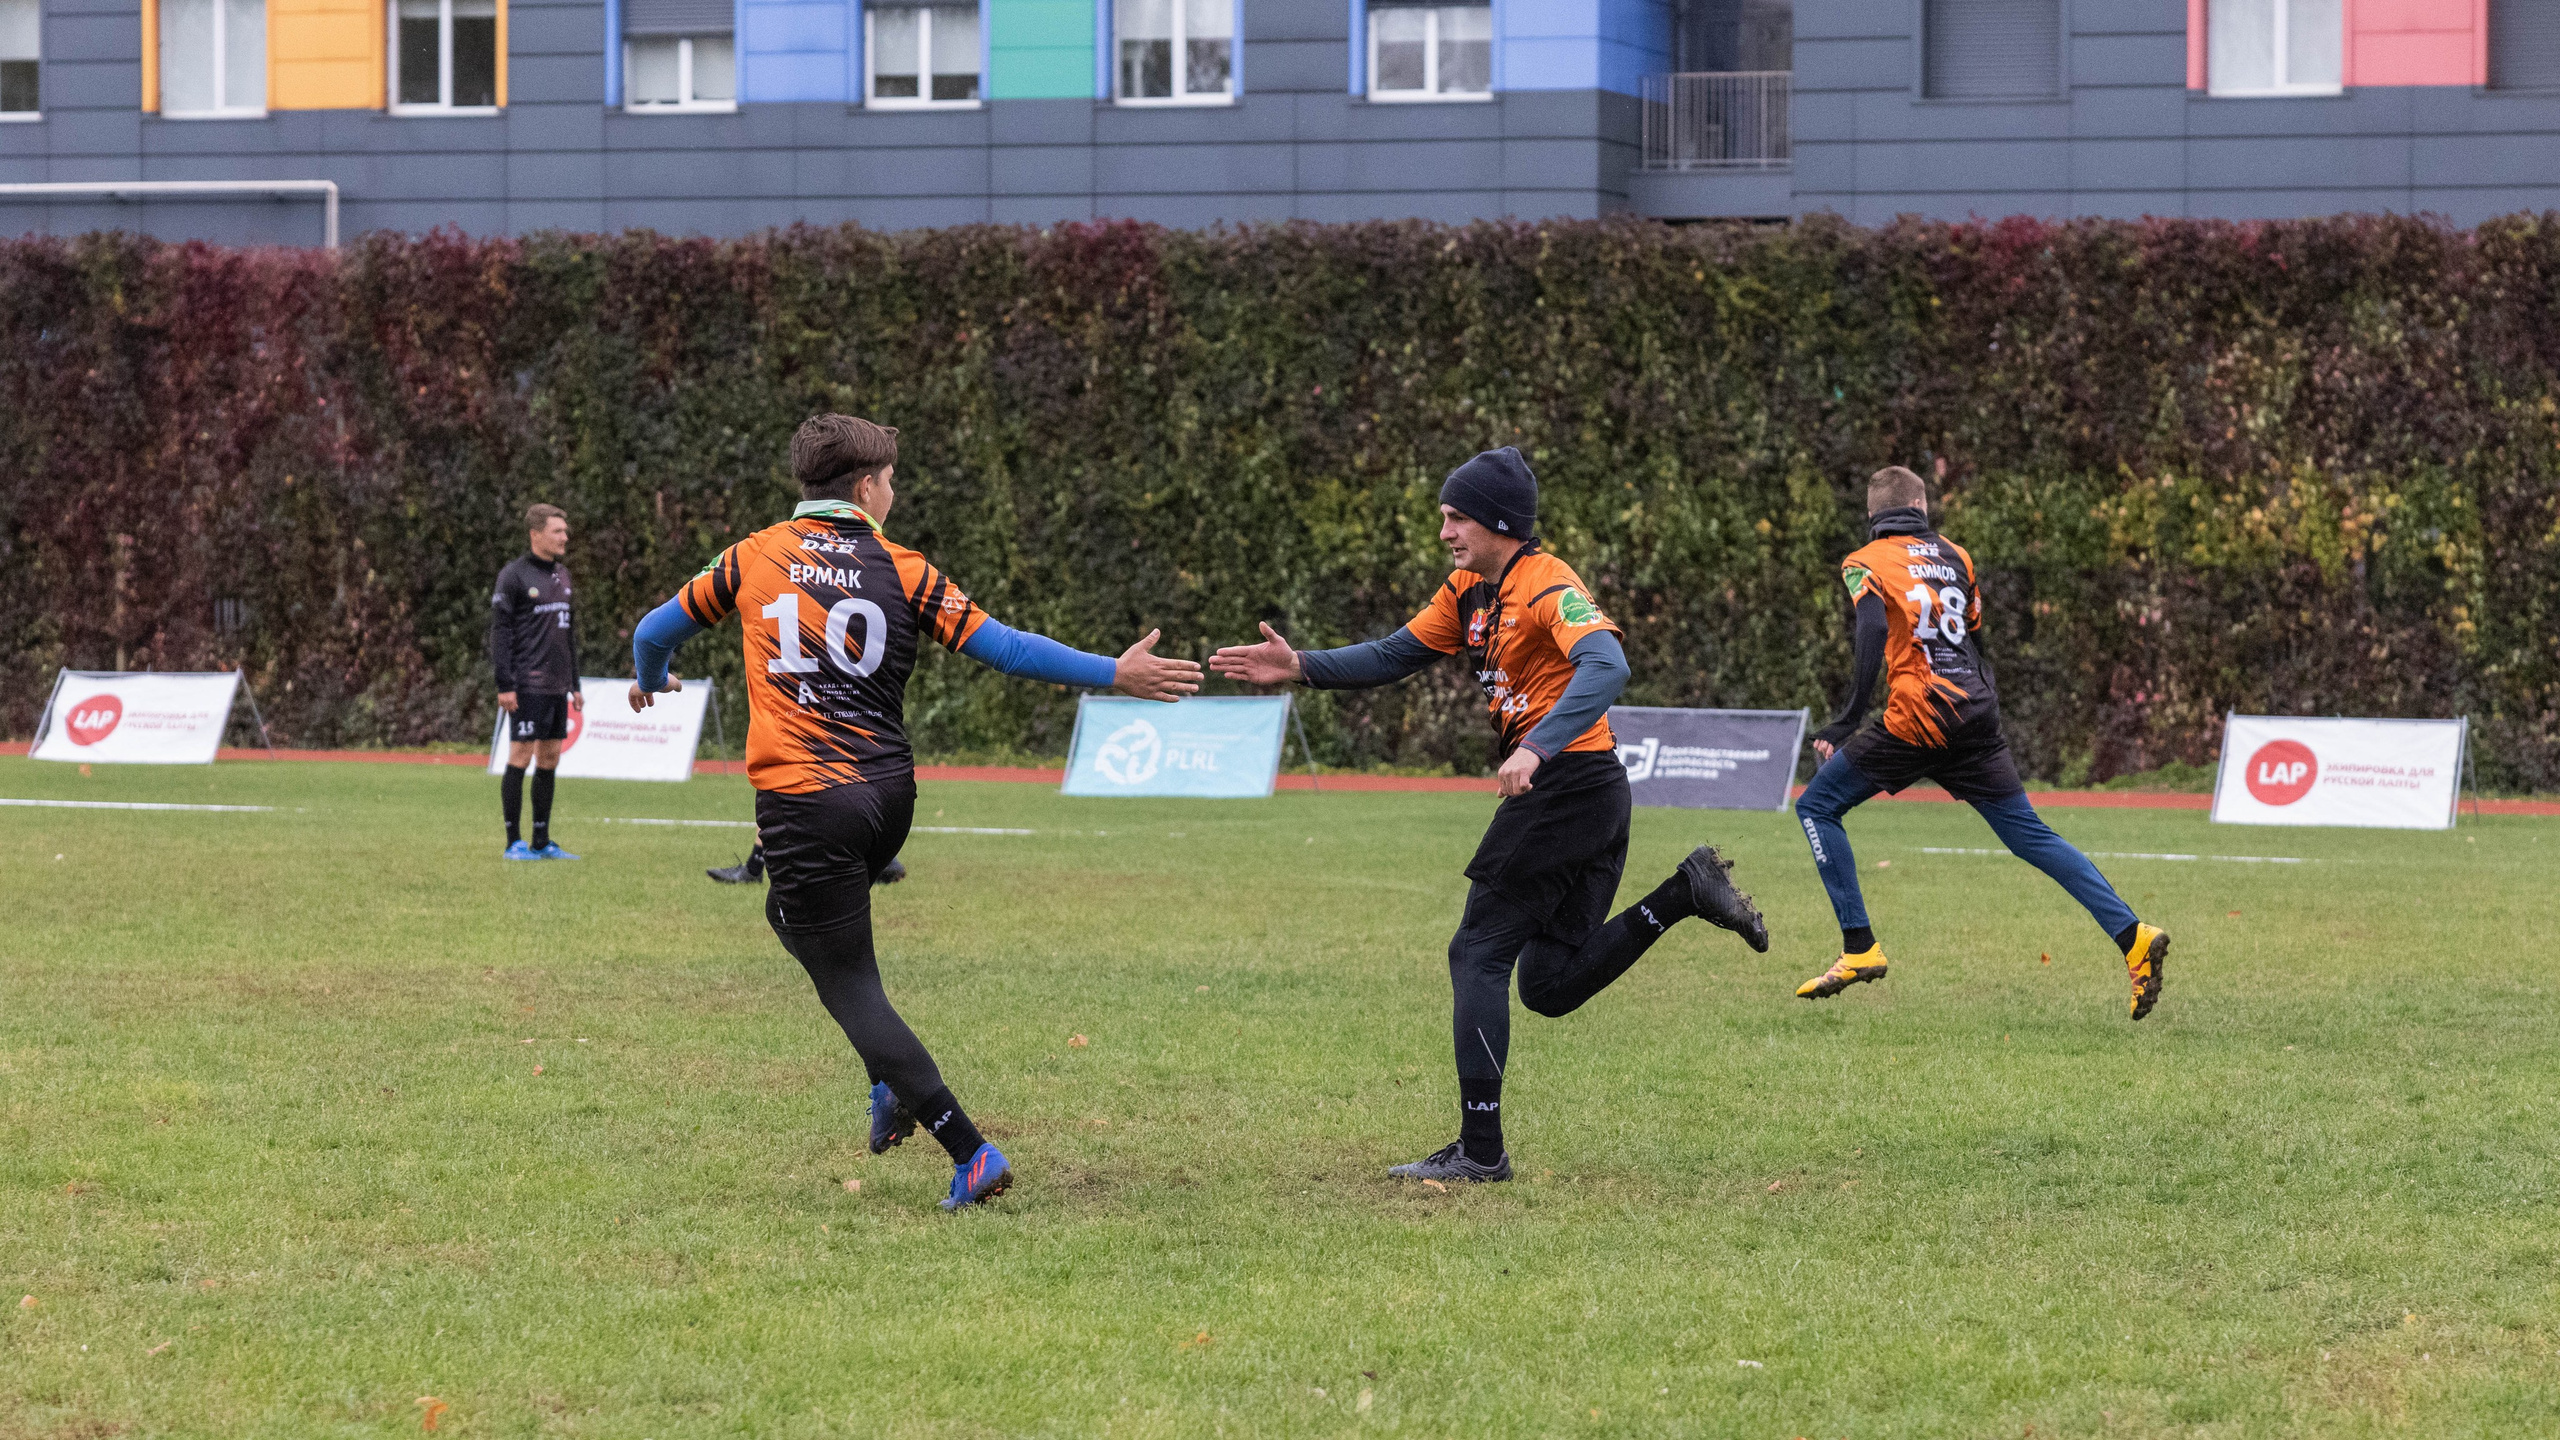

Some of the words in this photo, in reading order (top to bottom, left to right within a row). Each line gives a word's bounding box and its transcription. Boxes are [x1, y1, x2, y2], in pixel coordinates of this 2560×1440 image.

[789, 563, 862, 589] ЕРМАК
[1907, 564, 1957, 581] ЕКИМОВ
[1906, 584, 1967, 645] 18
[761, 593, 888, 678] 10
[1501, 693, 1529, 714] 43
[73, 709, 116, 730] LAP
[517, 720, 535, 736] 15
[2257, 760, 2309, 785] LAP
[2408, 767, 2435, 778] ДЛЯ
[1640, 905, 1665, 932] LAP
[1467, 1100, 1499, 1112] LAP
[927, 1110, 953, 1134] LAP
